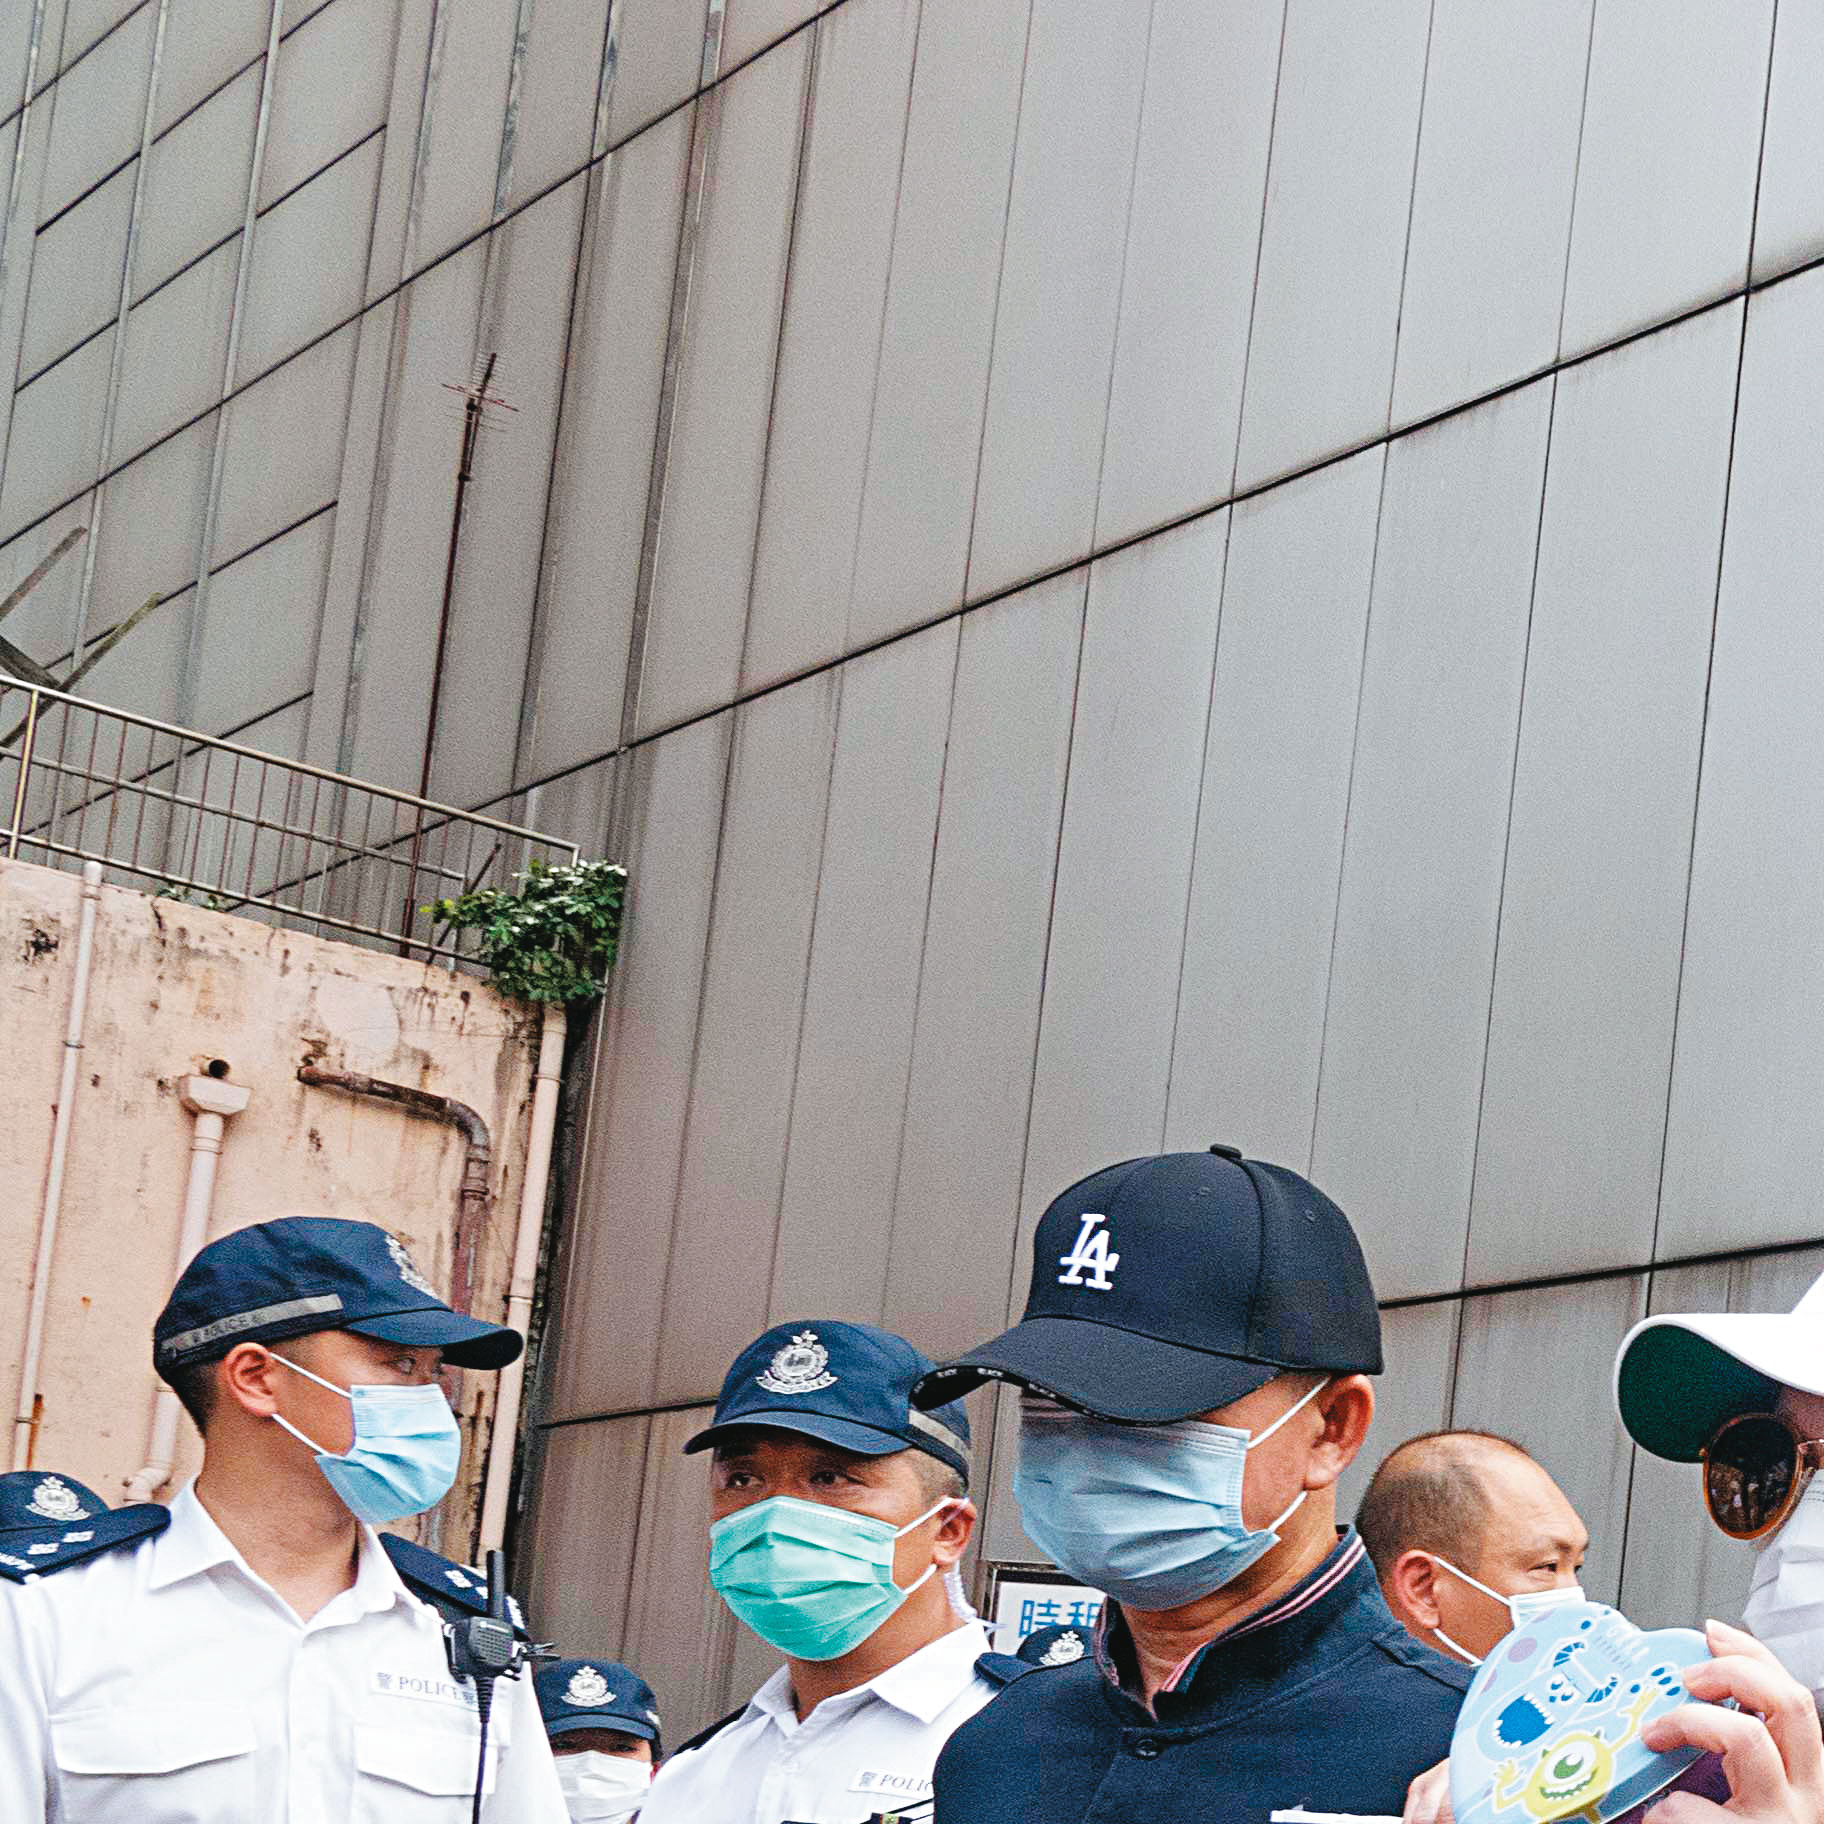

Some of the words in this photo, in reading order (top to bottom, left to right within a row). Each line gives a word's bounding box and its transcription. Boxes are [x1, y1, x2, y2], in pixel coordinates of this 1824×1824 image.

[1058, 1213, 1120, 1291] LA
[399, 1676, 461, 1702] POLICE
[880, 1774, 932, 1792] POLIC
